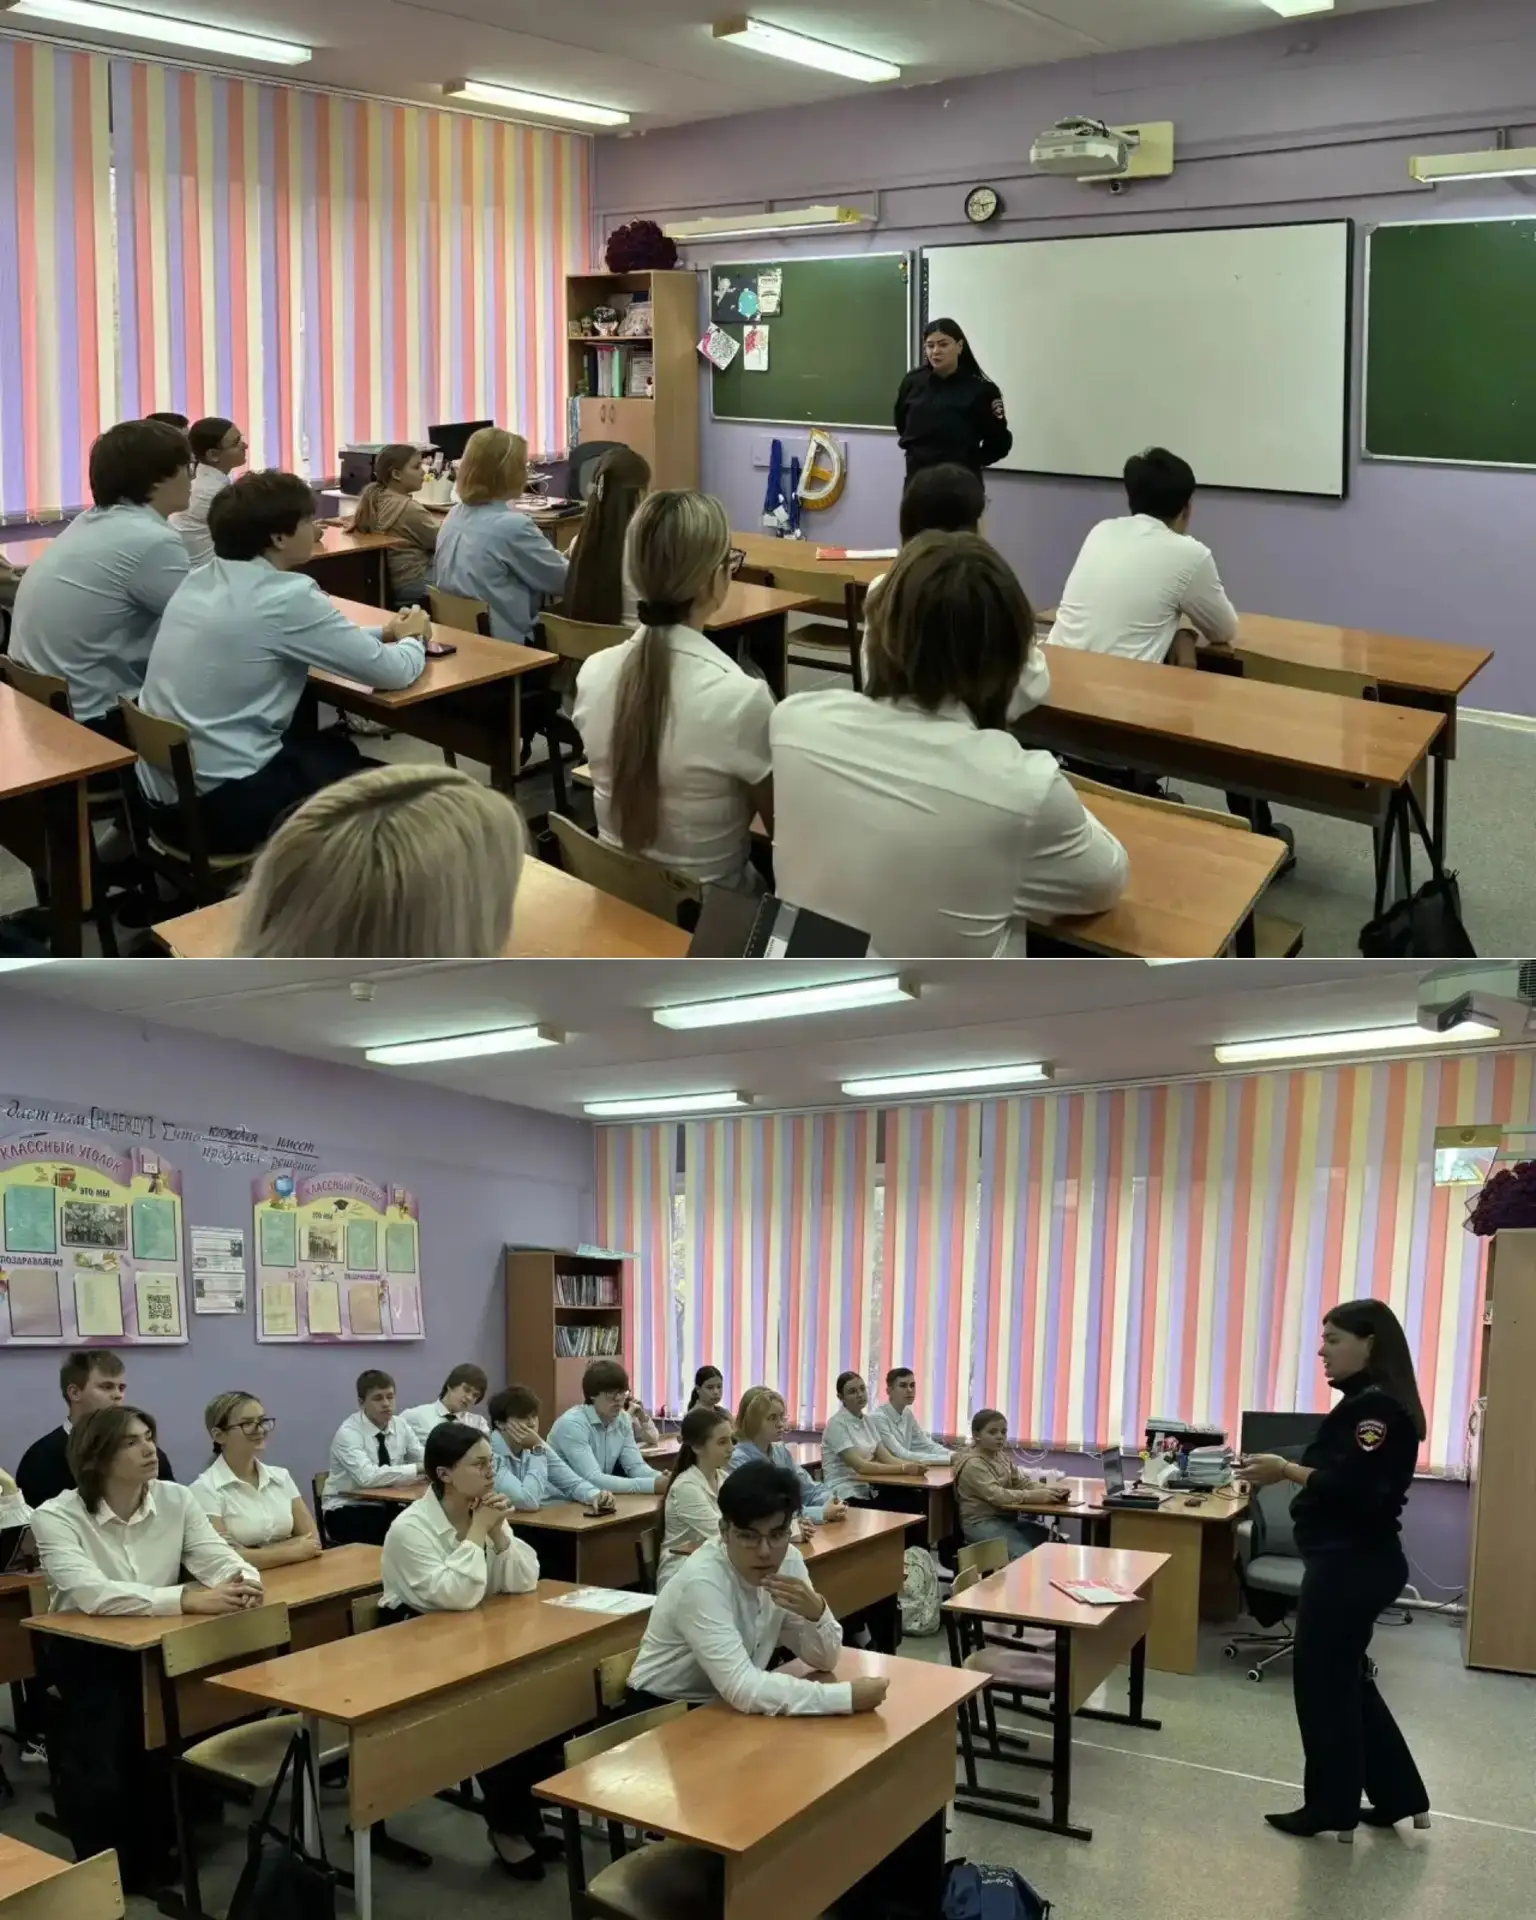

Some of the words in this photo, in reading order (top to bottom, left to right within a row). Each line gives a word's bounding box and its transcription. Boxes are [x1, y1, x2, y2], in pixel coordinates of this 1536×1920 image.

[0, 1139, 75, 1160] КЛАССНЫЙ
[79, 1144, 124, 1173] УГОЛОК
[79, 1187, 94, 1196] ЭТО
[96, 1188, 110, 1198] МЫ
